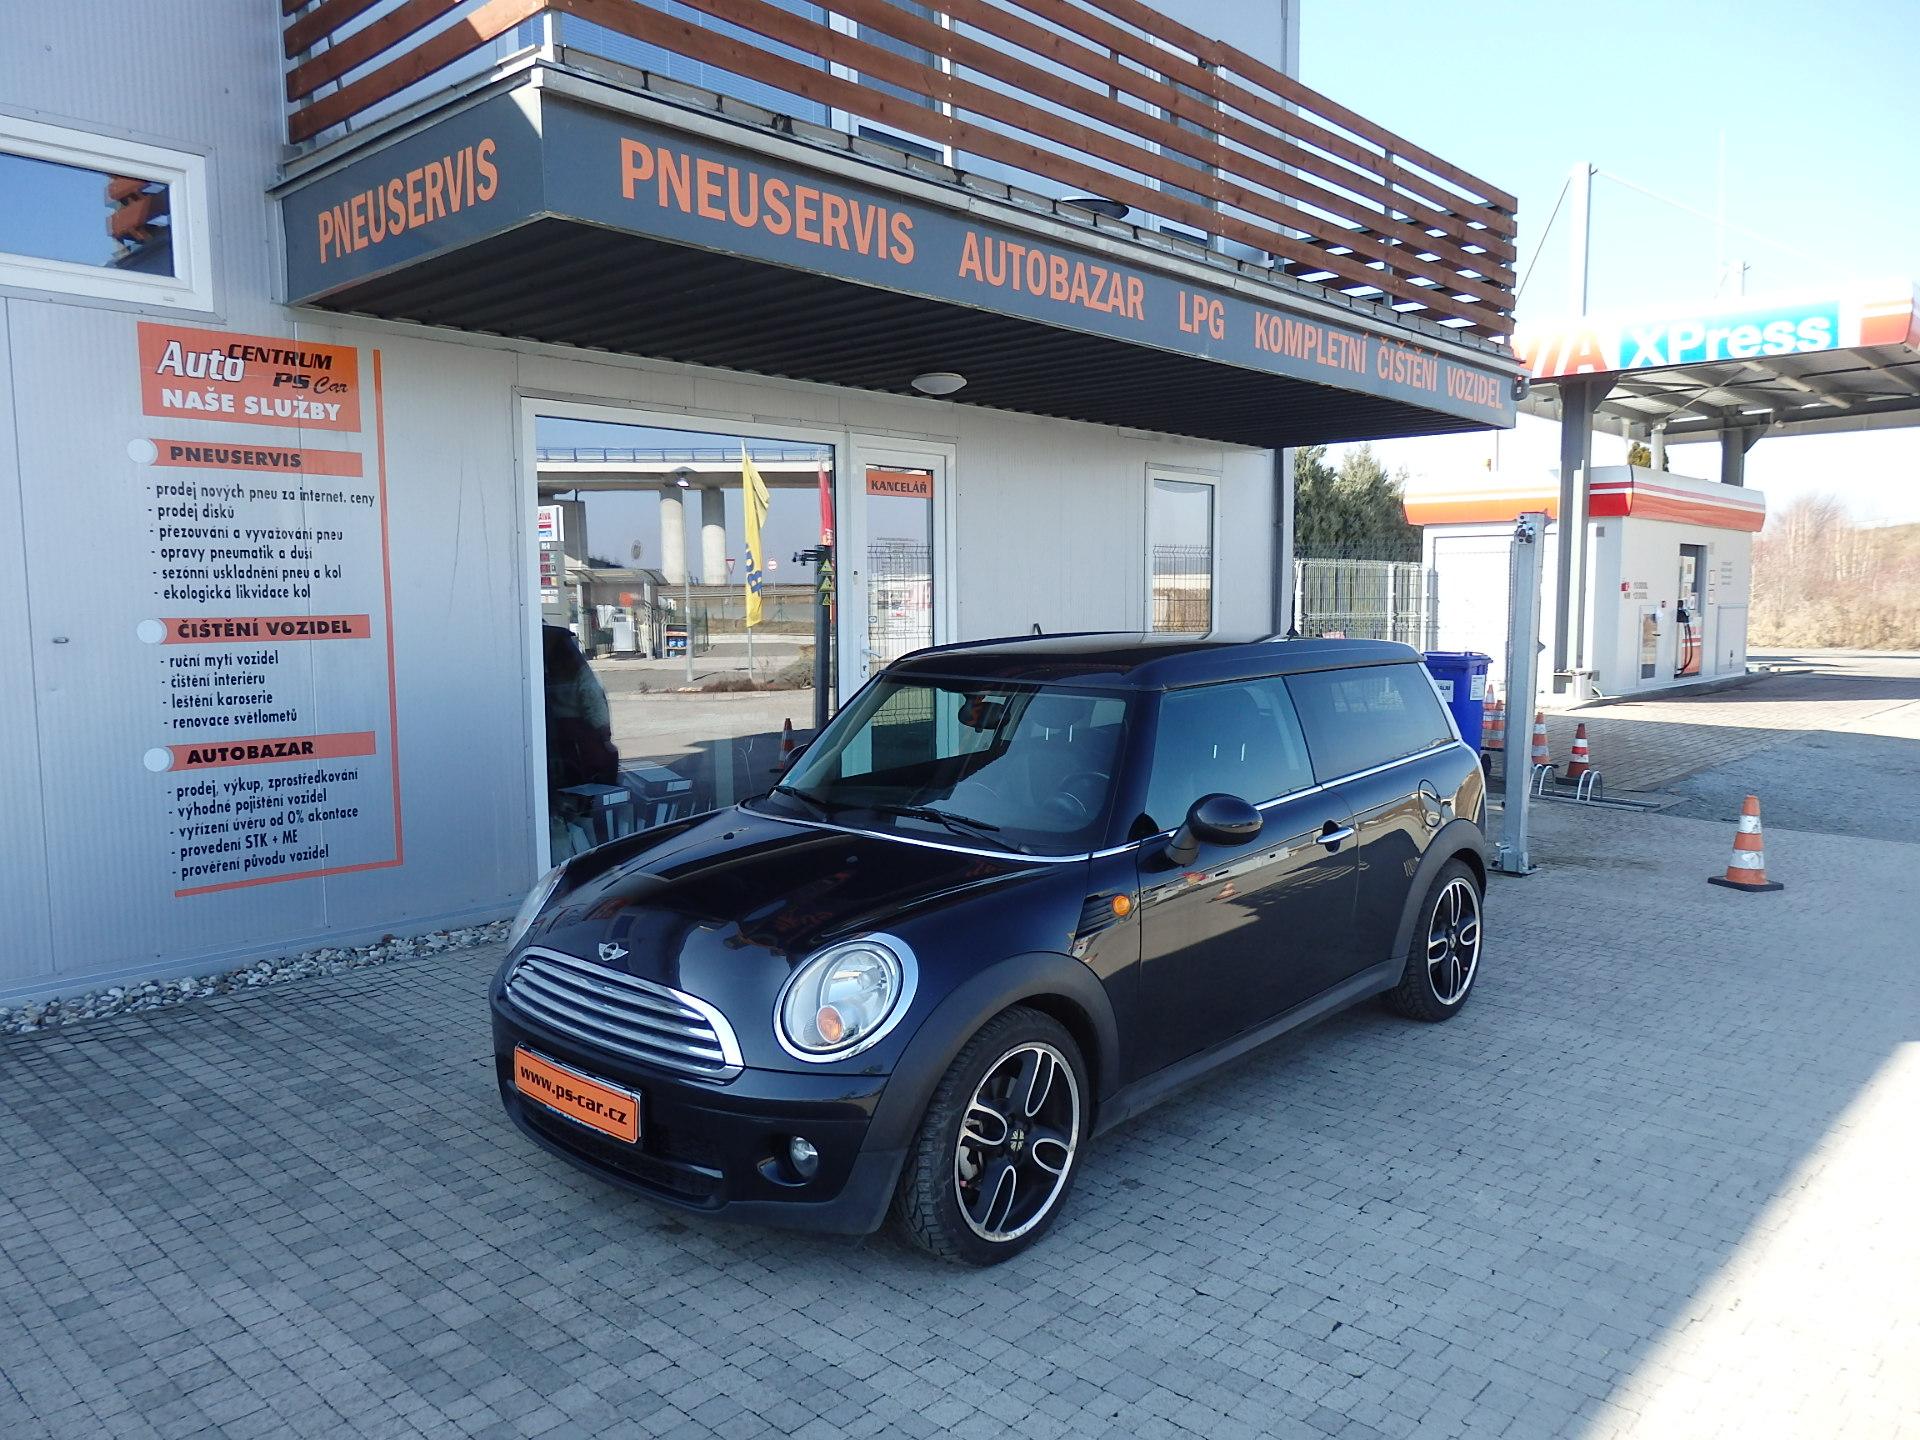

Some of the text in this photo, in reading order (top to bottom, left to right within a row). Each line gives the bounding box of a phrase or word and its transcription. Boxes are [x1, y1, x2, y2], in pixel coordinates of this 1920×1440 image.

[318, 138, 497, 264] PNEUSERVIS
[620, 137, 1504, 408] PNEUSERVIS AUTOBAZAR LPG KOMPLETNÍ ČIŠTĚNÍ VOZIDEL
[1628, 316, 1832, 370] XPress
[156, 339, 245, 382] Auto
[228, 344, 333, 370] CENTRUM
[273, 372, 349, 395] PS Car
[162, 387, 341, 421] NAŠE SLUŽBY
[170, 446, 302, 467] PNEUSERVIS
[156, 481, 375, 508] prodej nových pneu za internet. ceny
[871, 481, 927, 494] KANCELÁŘ
[158, 502, 198, 521] prodej
[159, 524, 343, 543] přezouvání a vyvažování pneu
[160, 548, 205, 562] opravy
[210, 544, 274, 562] pneumatik
[279, 549, 285, 559] a
[162, 564, 342, 582] sezónní uskladnění pneu a kol
[163, 583, 311, 603] ekologická likvidace kol
[178, 618, 352, 638] ČIŠTĚNÍ VOZIDEL
[169, 650, 279, 669] ruční mytí vozidel
[171, 671, 265, 688] čištění interiéru
[172, 690, 273, 709] leštění karoserie
[173, 708, 298, 729] renovace světlometů
[187, 741, 314, 764] AUTOBAZAR
[177, 768, 359, 801] prodej, výkup, zprostředkování
[178, 788, 327, 820] výhodné pojištění vozidel
[179, 807, 359, 840] vyřízení úvěru od 0% akontace
[180, 838, 241, 861] provedení
[245, 833, 268, 849] STK
[282, 829, 298, 844] ME
[181, 844, 329, 881] prověření původu vozidel
[520, 1066, 628, 1125] www.ps-car.cz
